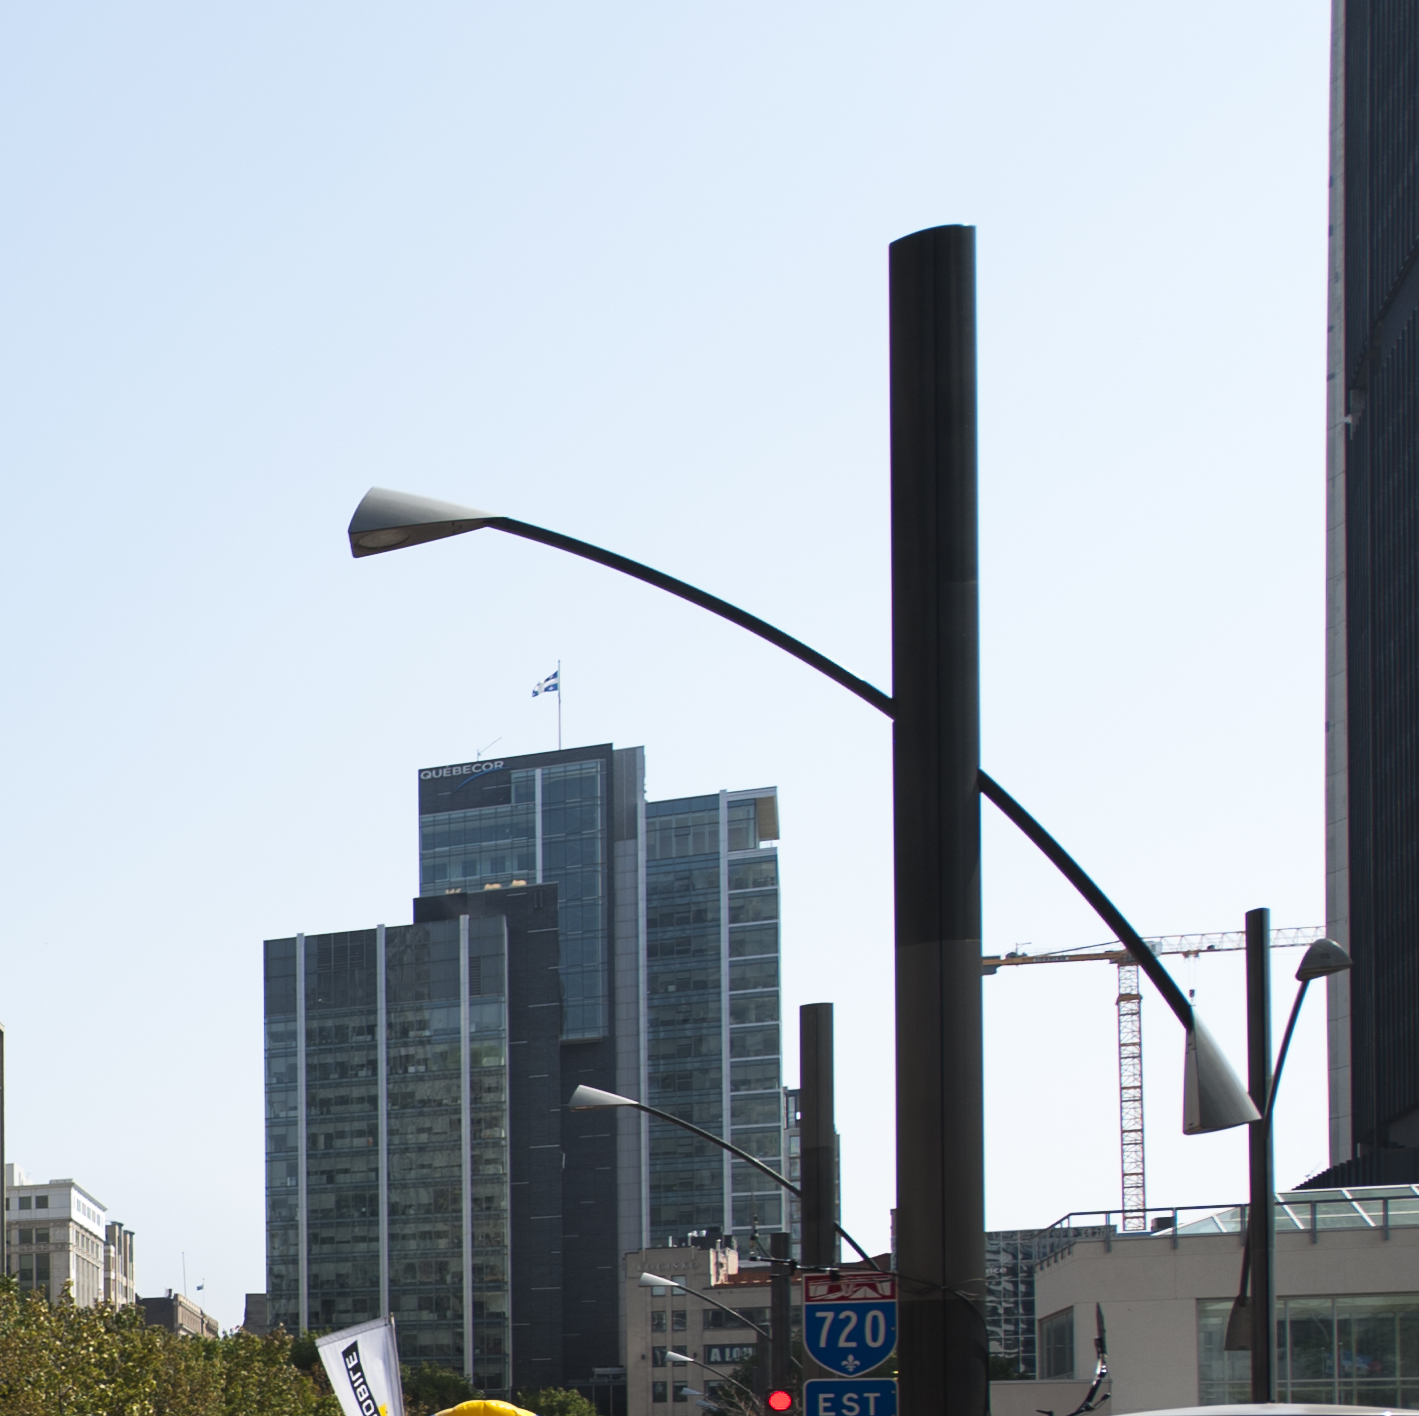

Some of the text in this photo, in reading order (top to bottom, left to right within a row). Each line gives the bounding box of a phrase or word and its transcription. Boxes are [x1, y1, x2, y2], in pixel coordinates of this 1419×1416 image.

[420, 761, 504, 780] QUÉBECOR
[815, 1309, 886, 1348] 720
[818, 1392, 881, 1416] EST
